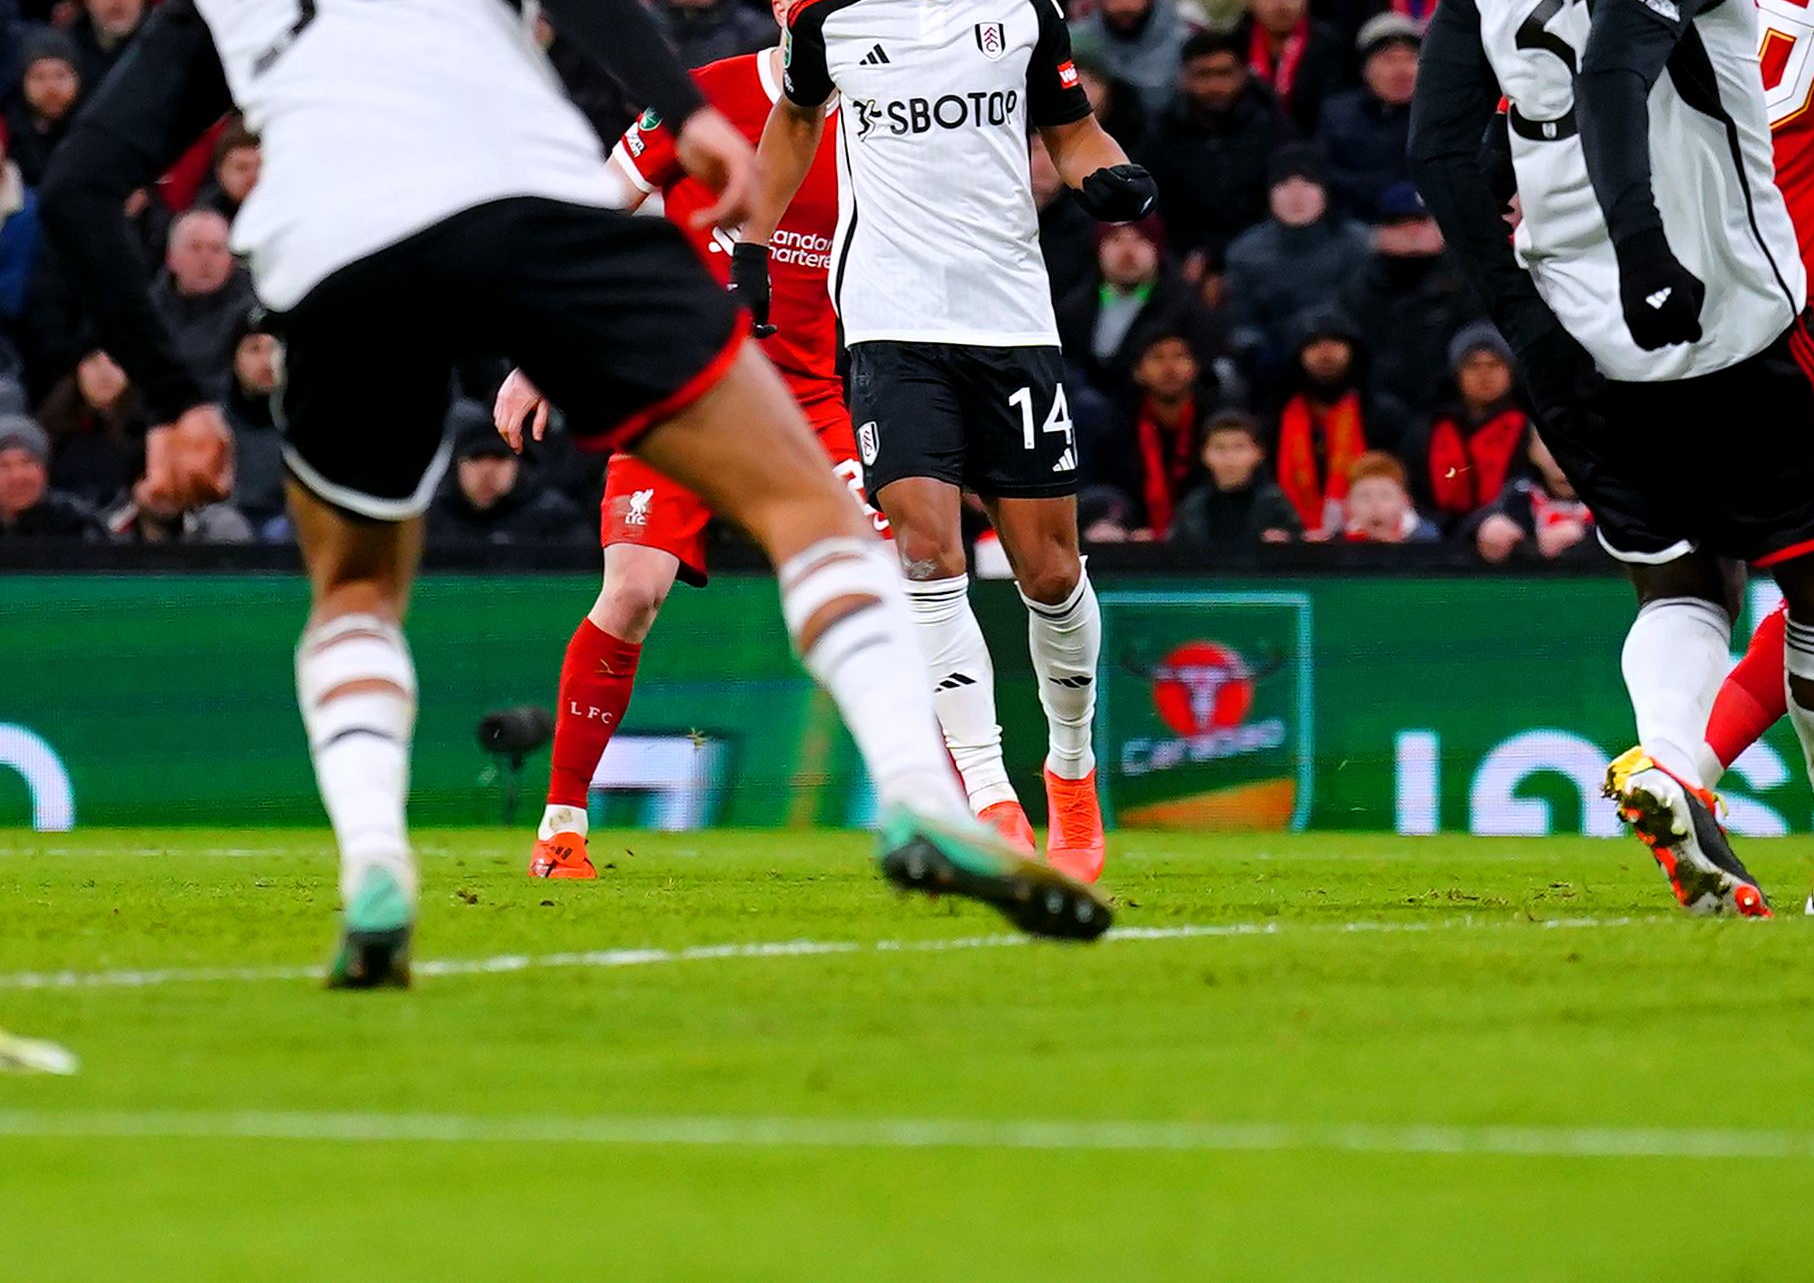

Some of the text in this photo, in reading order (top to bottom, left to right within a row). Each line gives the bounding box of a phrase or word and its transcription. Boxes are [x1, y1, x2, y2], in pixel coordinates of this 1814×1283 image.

[889, 90, 1017, 136] SBOTOP
[769, 230, 833, 252] andar
[769, 246, 831, 270] artere
[1008, 382, 1073, 450] 14
[625, 514, 646, 526] LFC
